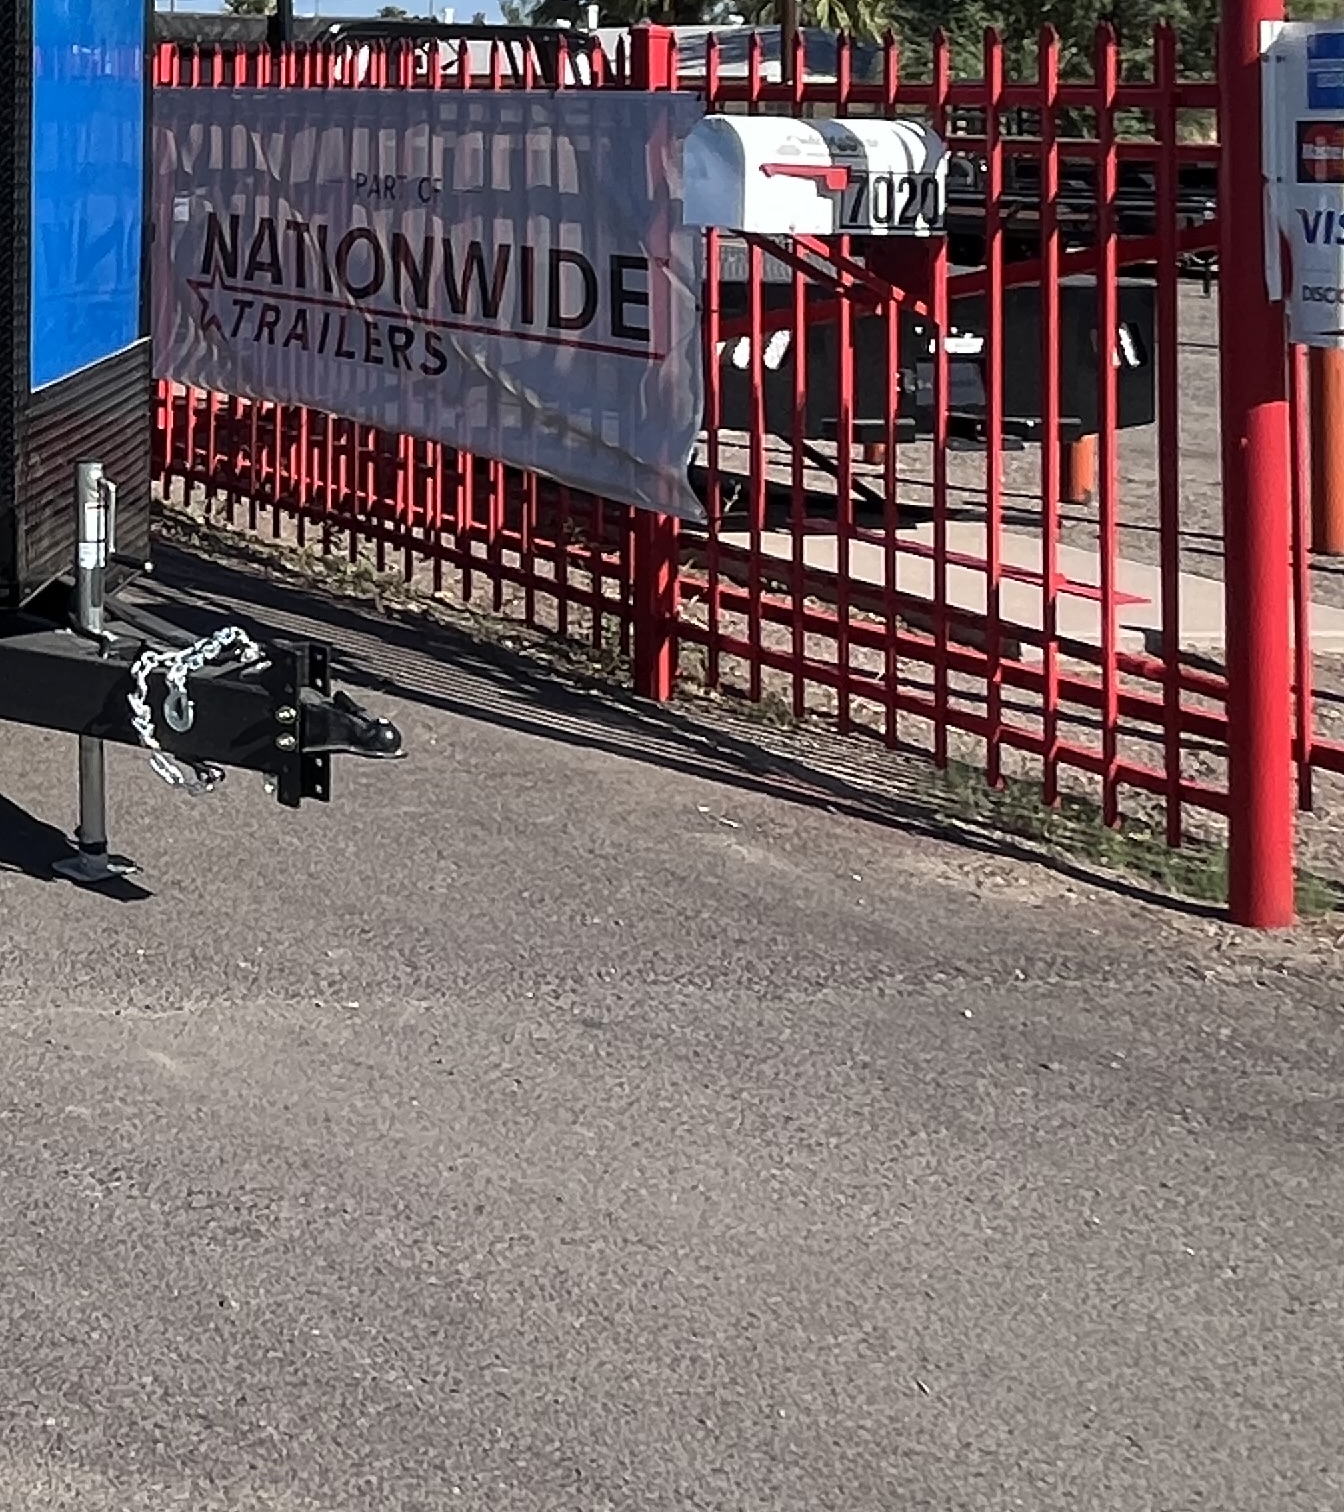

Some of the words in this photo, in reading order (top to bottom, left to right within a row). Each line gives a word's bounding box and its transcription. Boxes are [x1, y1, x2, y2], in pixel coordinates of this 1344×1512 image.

[843, 175, 940, 226] 7020
[201, 211, 652, 343] NATIONWIDE
[230, 298, 449, 376] TRAILERS
